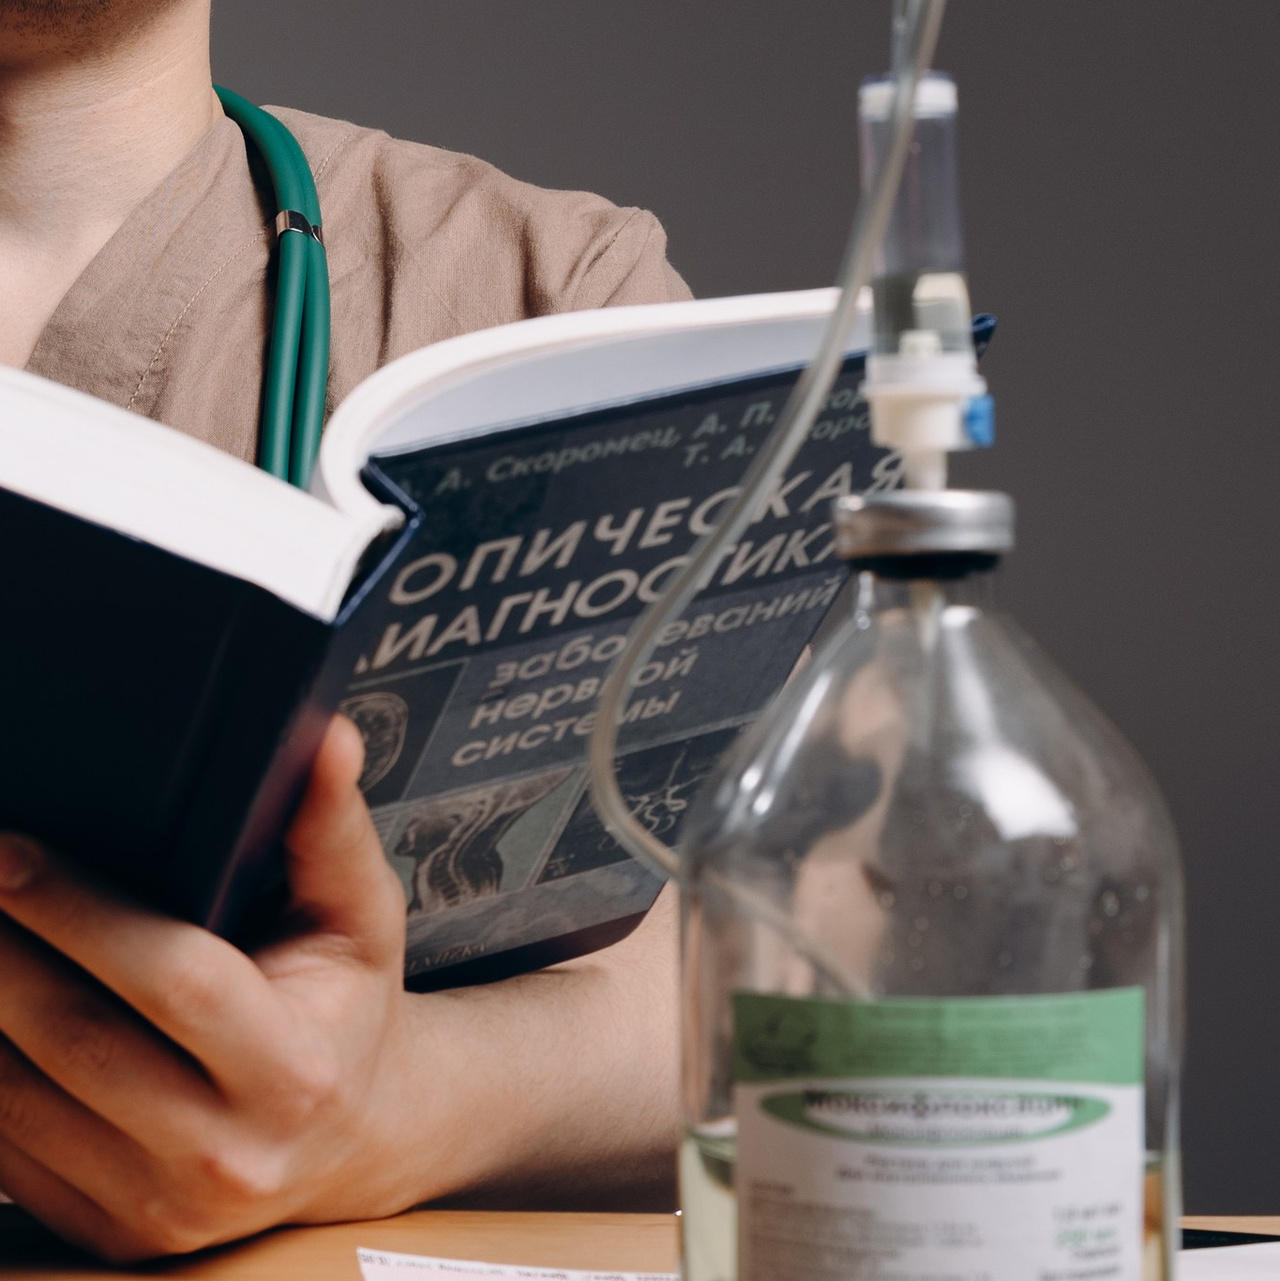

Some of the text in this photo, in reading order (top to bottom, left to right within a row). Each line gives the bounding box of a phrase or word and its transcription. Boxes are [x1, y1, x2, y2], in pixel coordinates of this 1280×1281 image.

[432, 468, 472, 495] А.
[692, 412, 727, 439] А.
[740, 401, 775, 429] П.
[684, 434, 755, 468] Т. А.
[388, 449, 903, 605] ОПИЧЕСКАЯ
[487, 574, 842, 689] забоеваний
[468, 644, 700, 730] нервой
